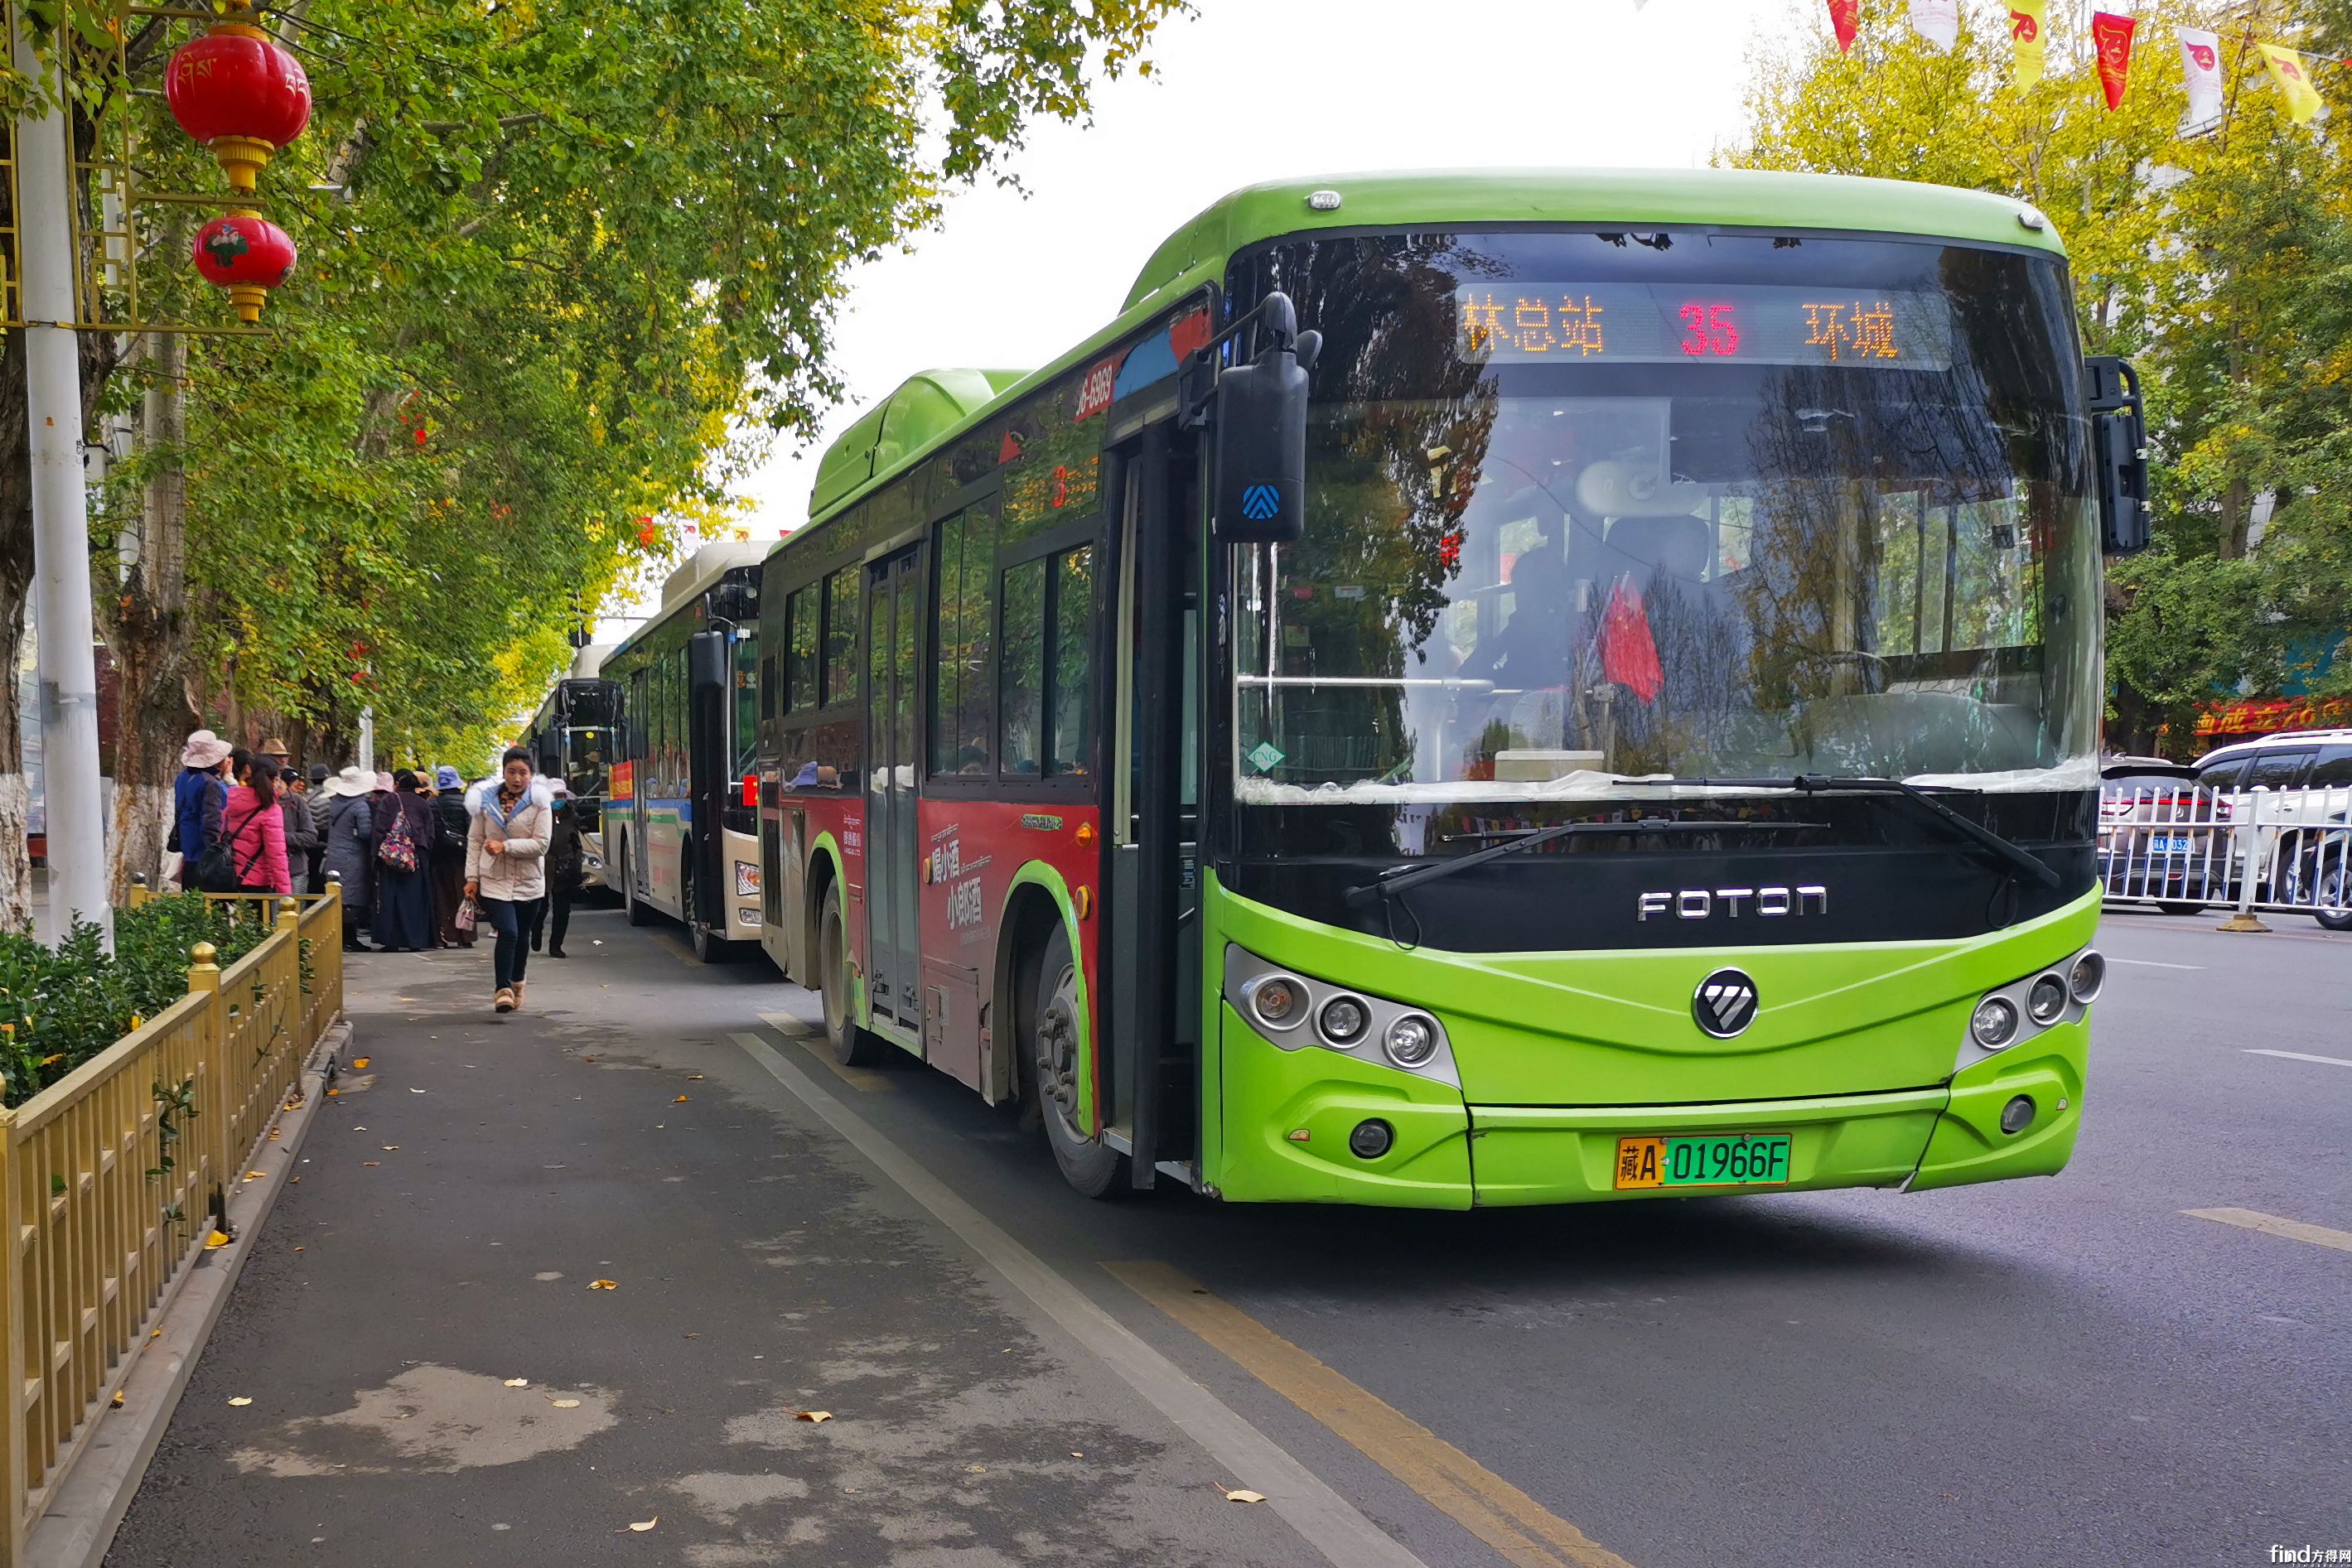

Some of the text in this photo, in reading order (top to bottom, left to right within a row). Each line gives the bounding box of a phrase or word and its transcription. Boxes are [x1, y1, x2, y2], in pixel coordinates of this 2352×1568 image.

[1464, 293, 1899, 361] 林总站 35 环城
[1253, 751, 1277, 762] CNG
[948, 876, 982, 930] 小郎酒
[1638, 886, 1826, 920] FOTON
